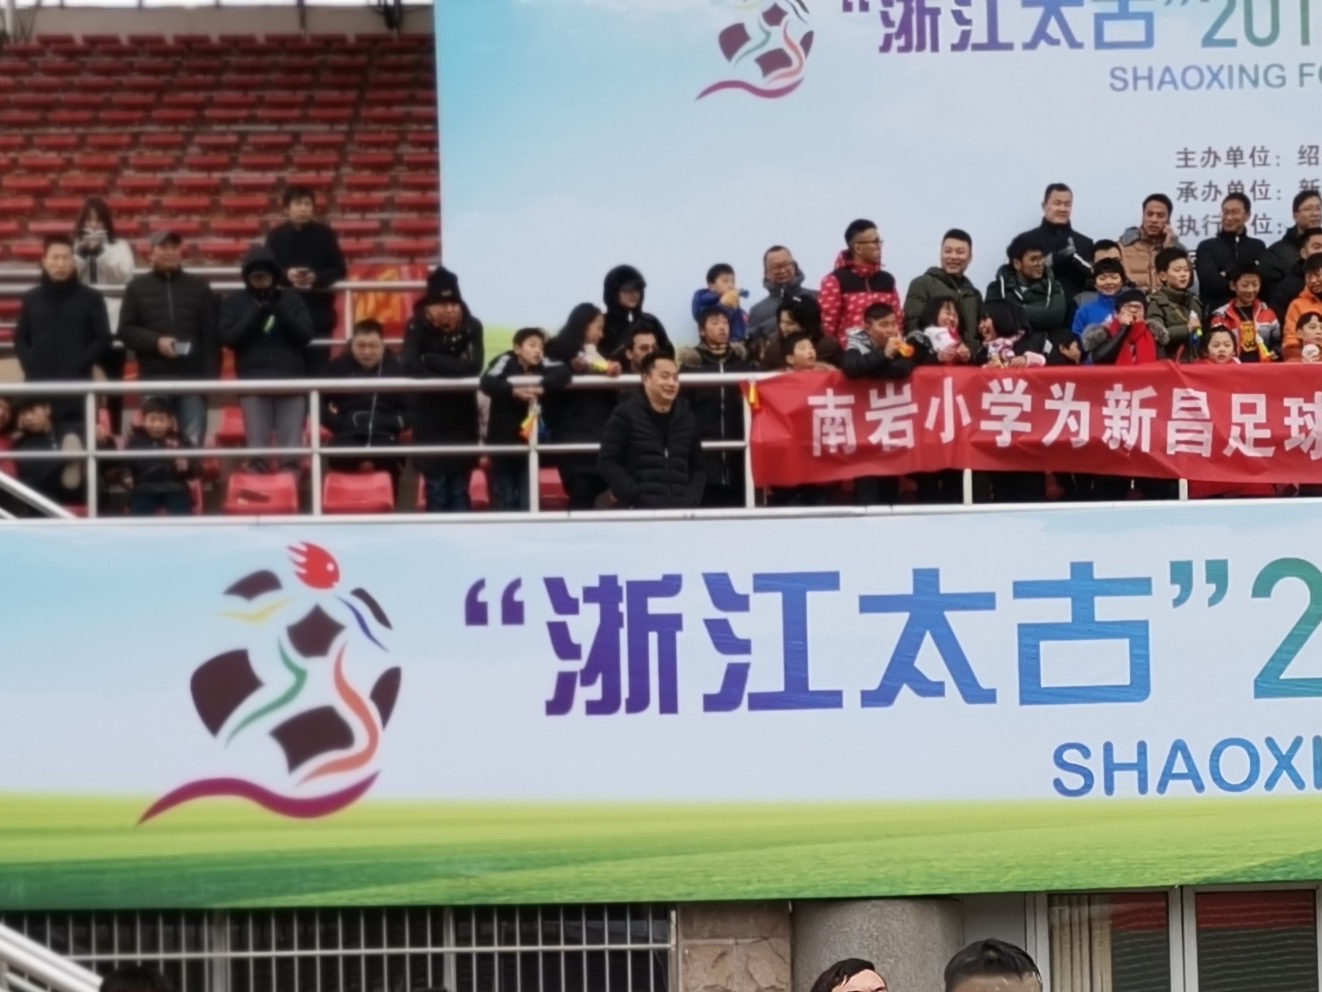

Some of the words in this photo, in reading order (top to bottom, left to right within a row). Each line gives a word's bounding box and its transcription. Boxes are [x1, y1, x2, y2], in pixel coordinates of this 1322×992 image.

[1108, 63, 1288, 93] SHAOXING
[1175, 145, 1282, 169] 主办单位：
[1176, 212, 1283, 238] 执行位：
